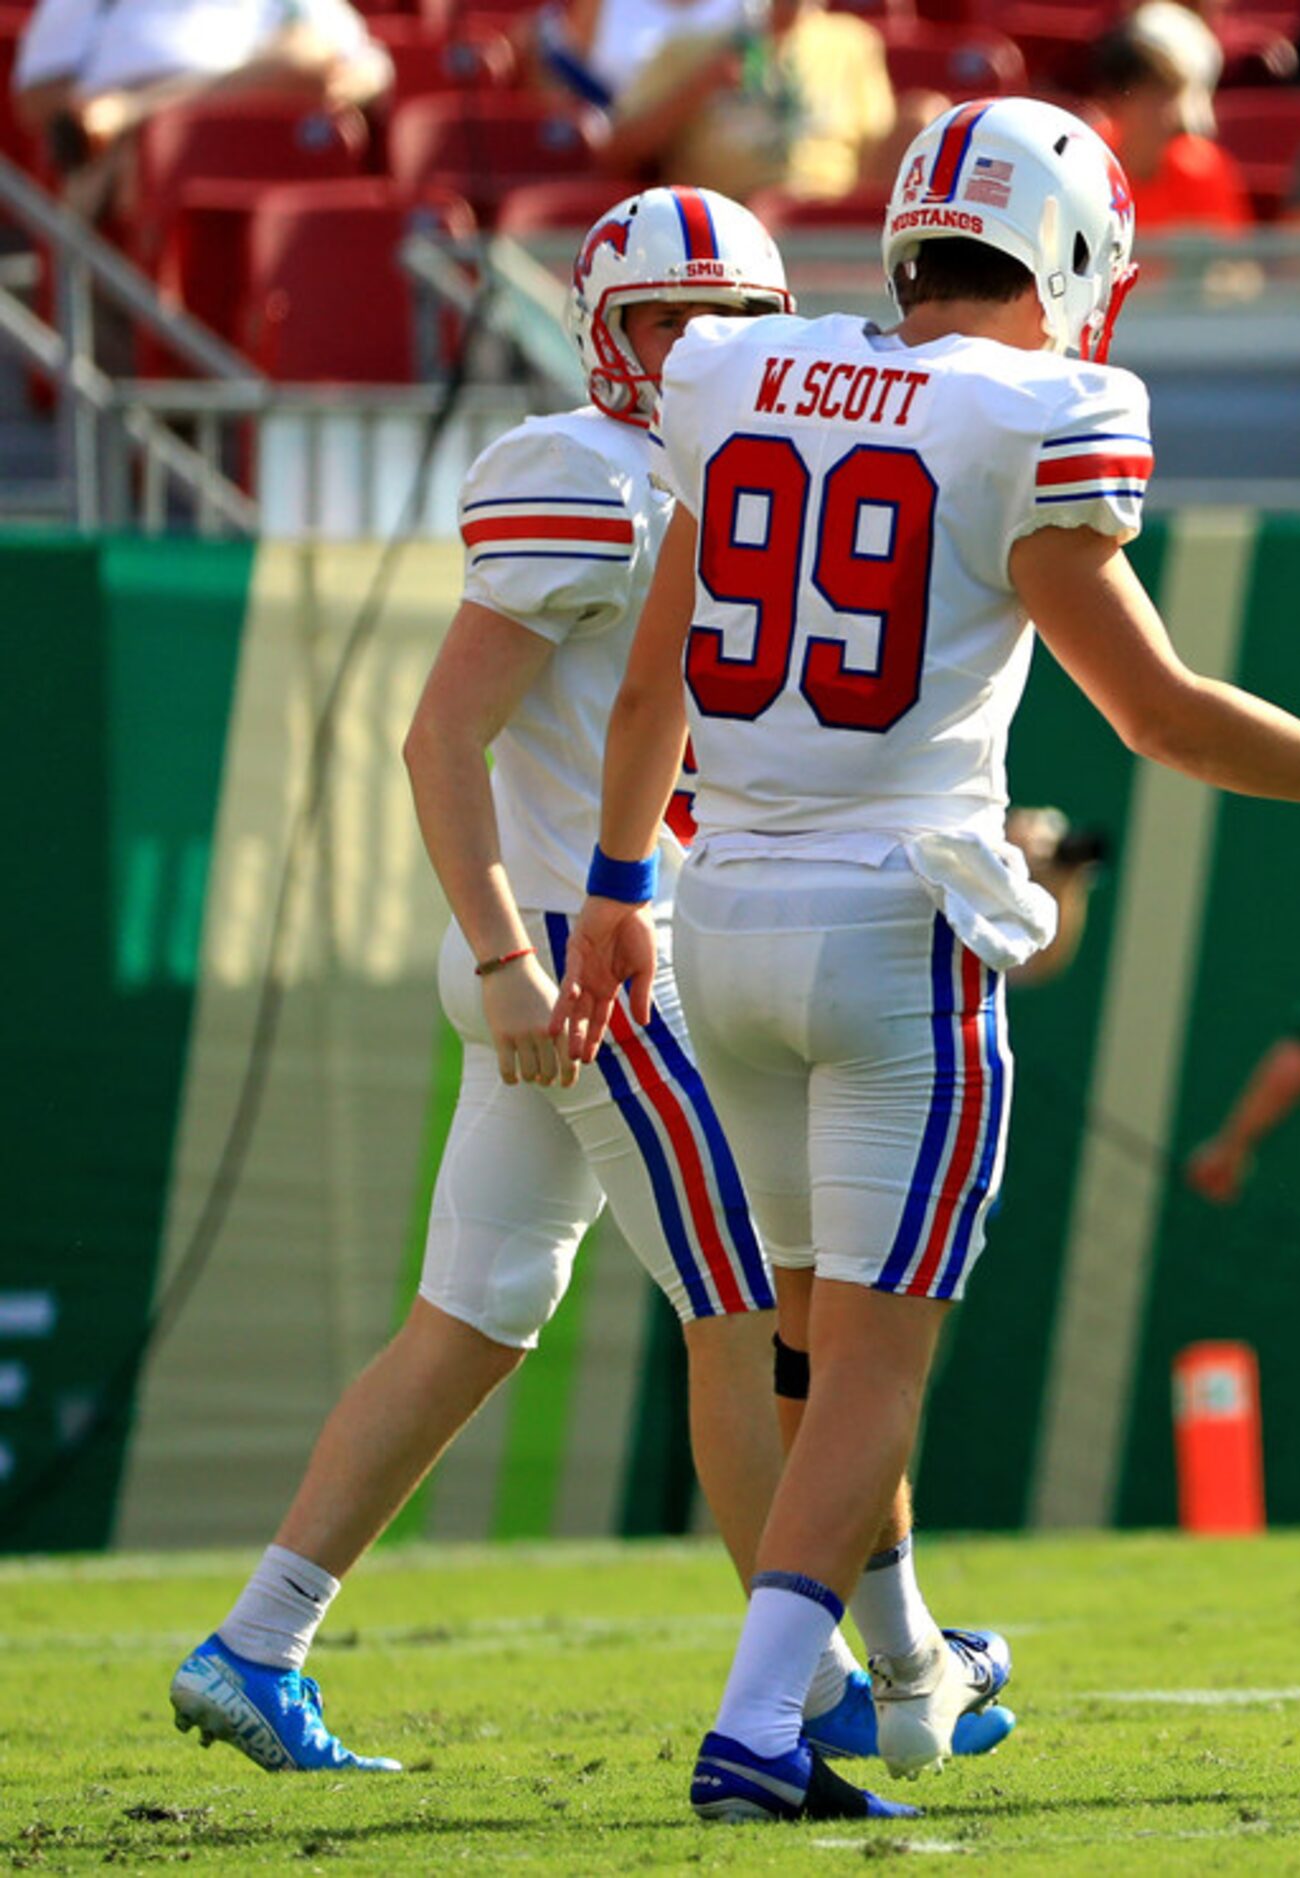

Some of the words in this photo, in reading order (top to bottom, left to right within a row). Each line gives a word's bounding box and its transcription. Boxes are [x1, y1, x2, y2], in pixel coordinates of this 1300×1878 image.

[891, 207, 983, 235] MUSTANGS
[686, 261, 724, 277] SMU
[685, 432, 939, 734] 99
